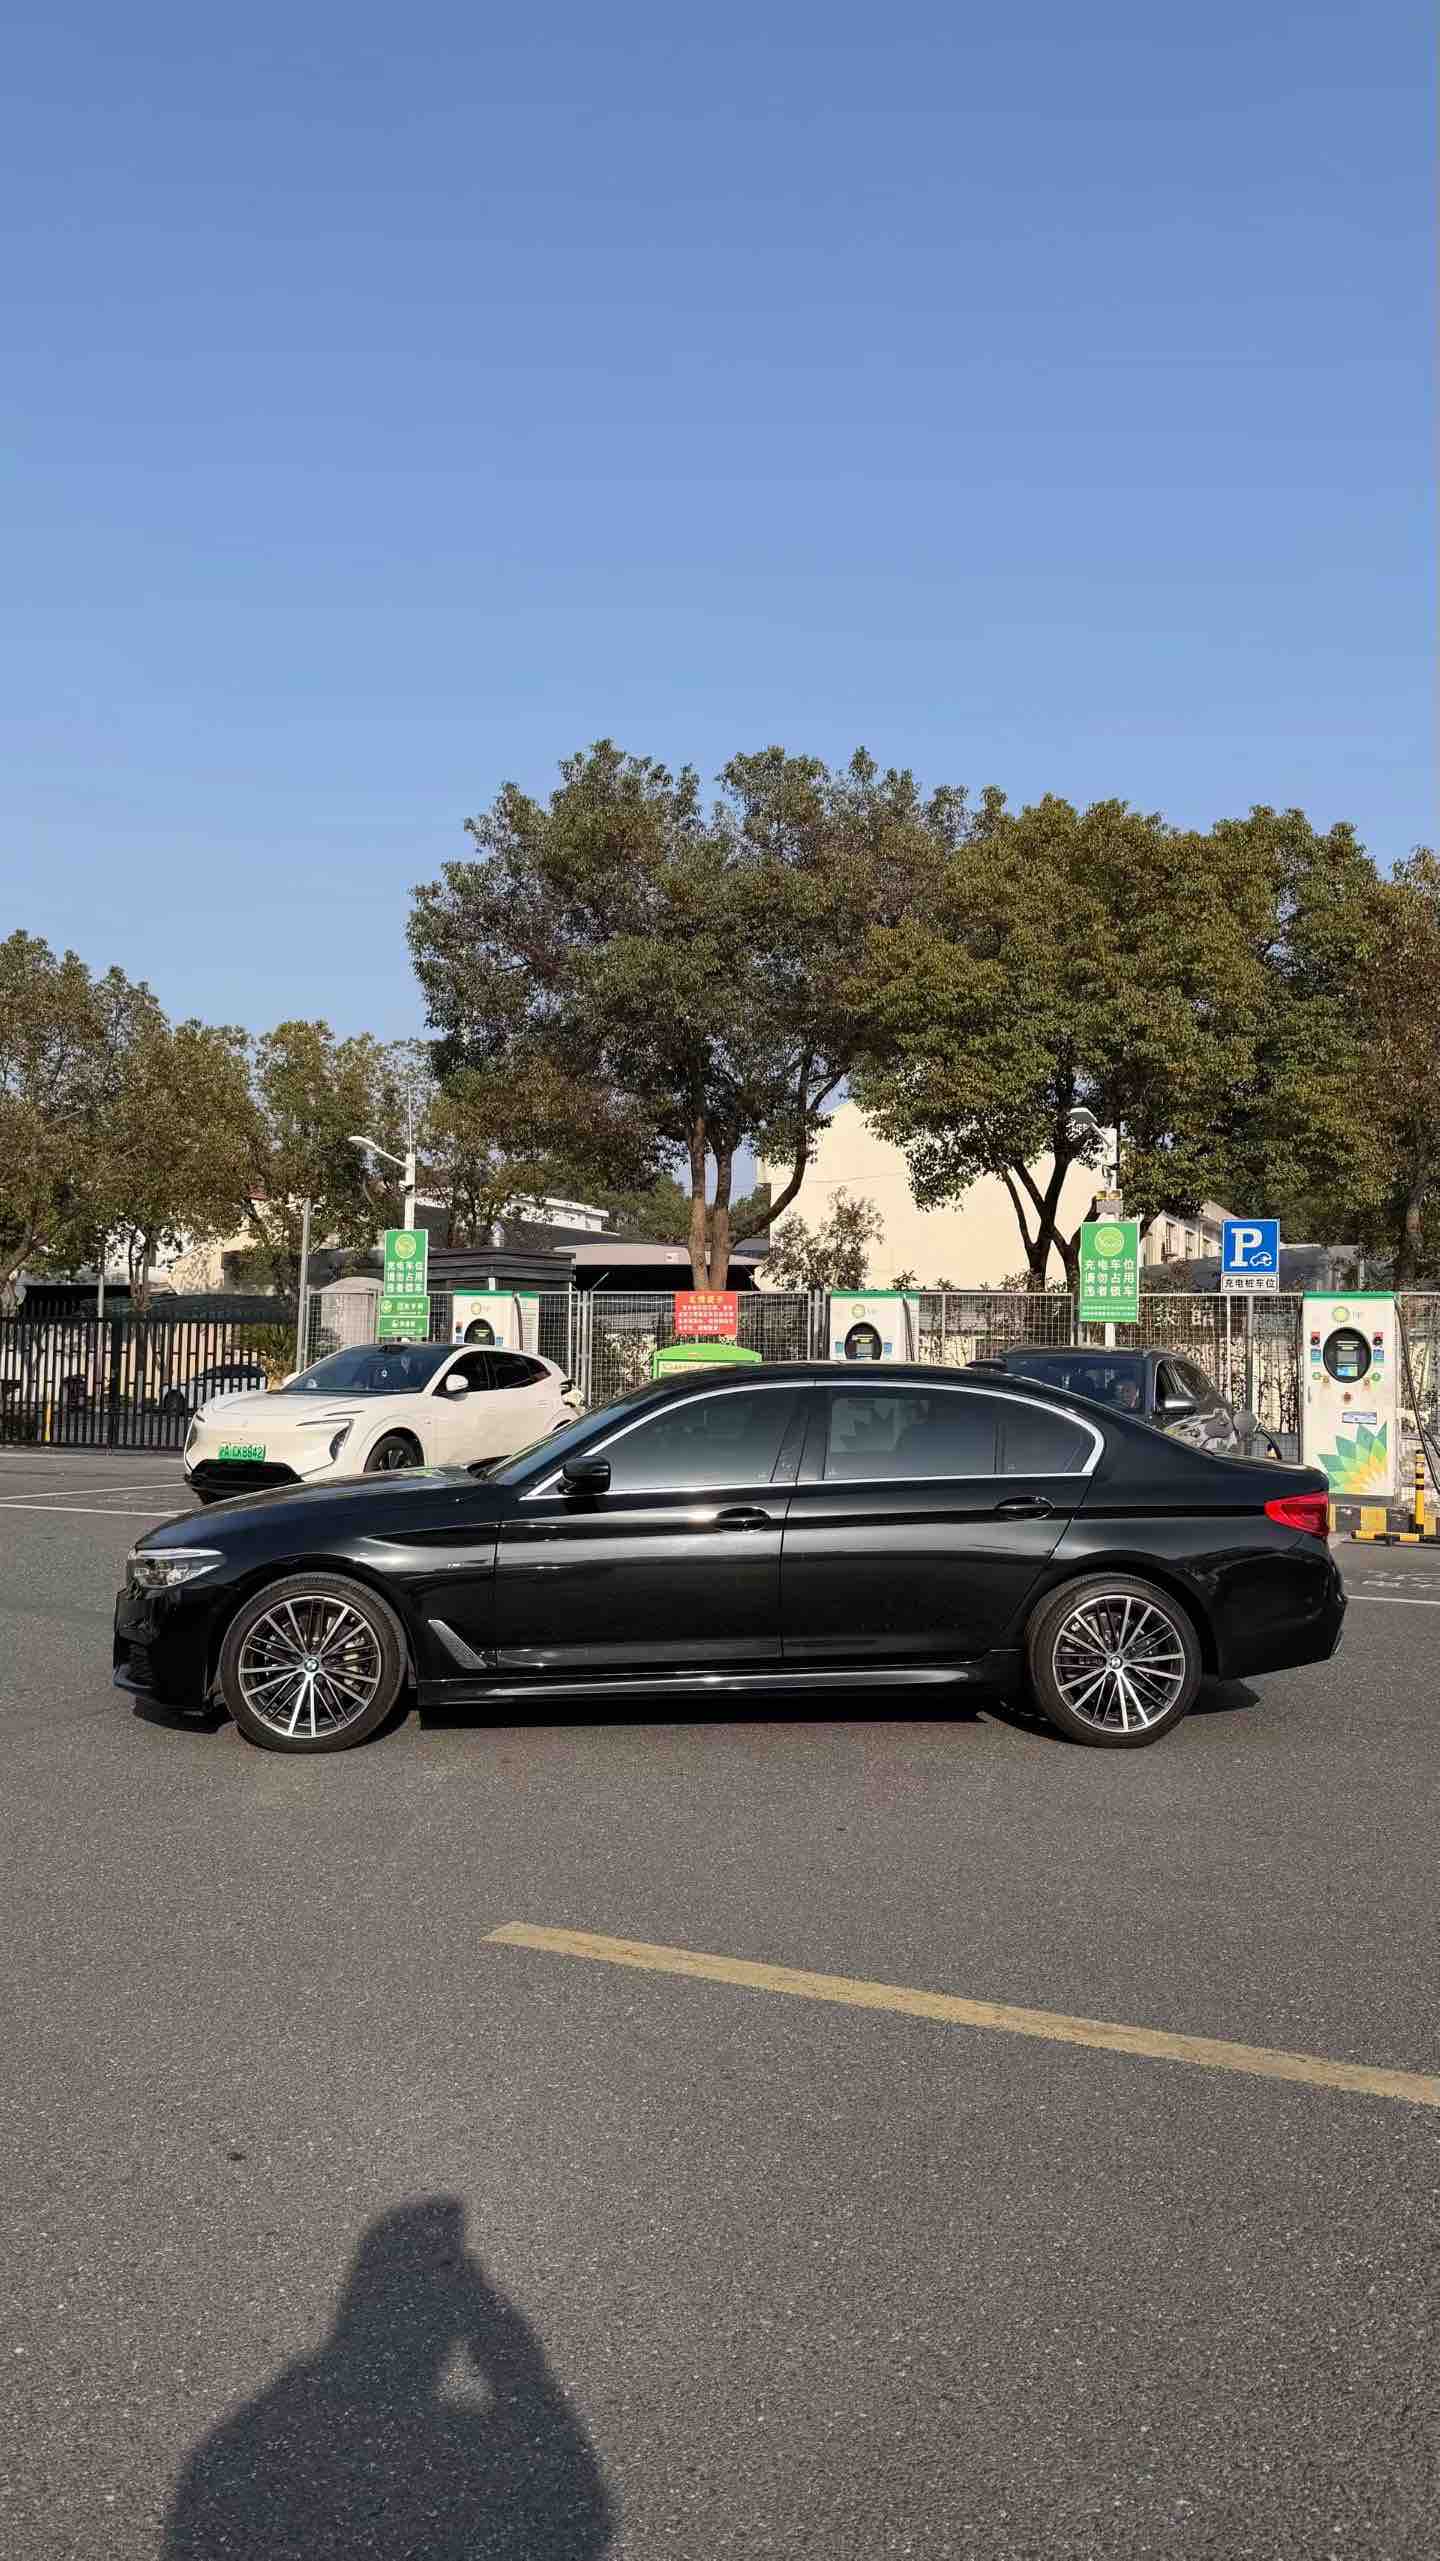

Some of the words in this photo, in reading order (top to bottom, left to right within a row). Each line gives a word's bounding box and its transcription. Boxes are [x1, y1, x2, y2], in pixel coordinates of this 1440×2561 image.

[1230, 1228, 1262, 1267] P
[1084, 1258, 1135, 1271] 充电车位
[1085, 1272, 1135, 1284] 请勿占用
[1225, 1279, 1275, 1288] 充电桩车位
